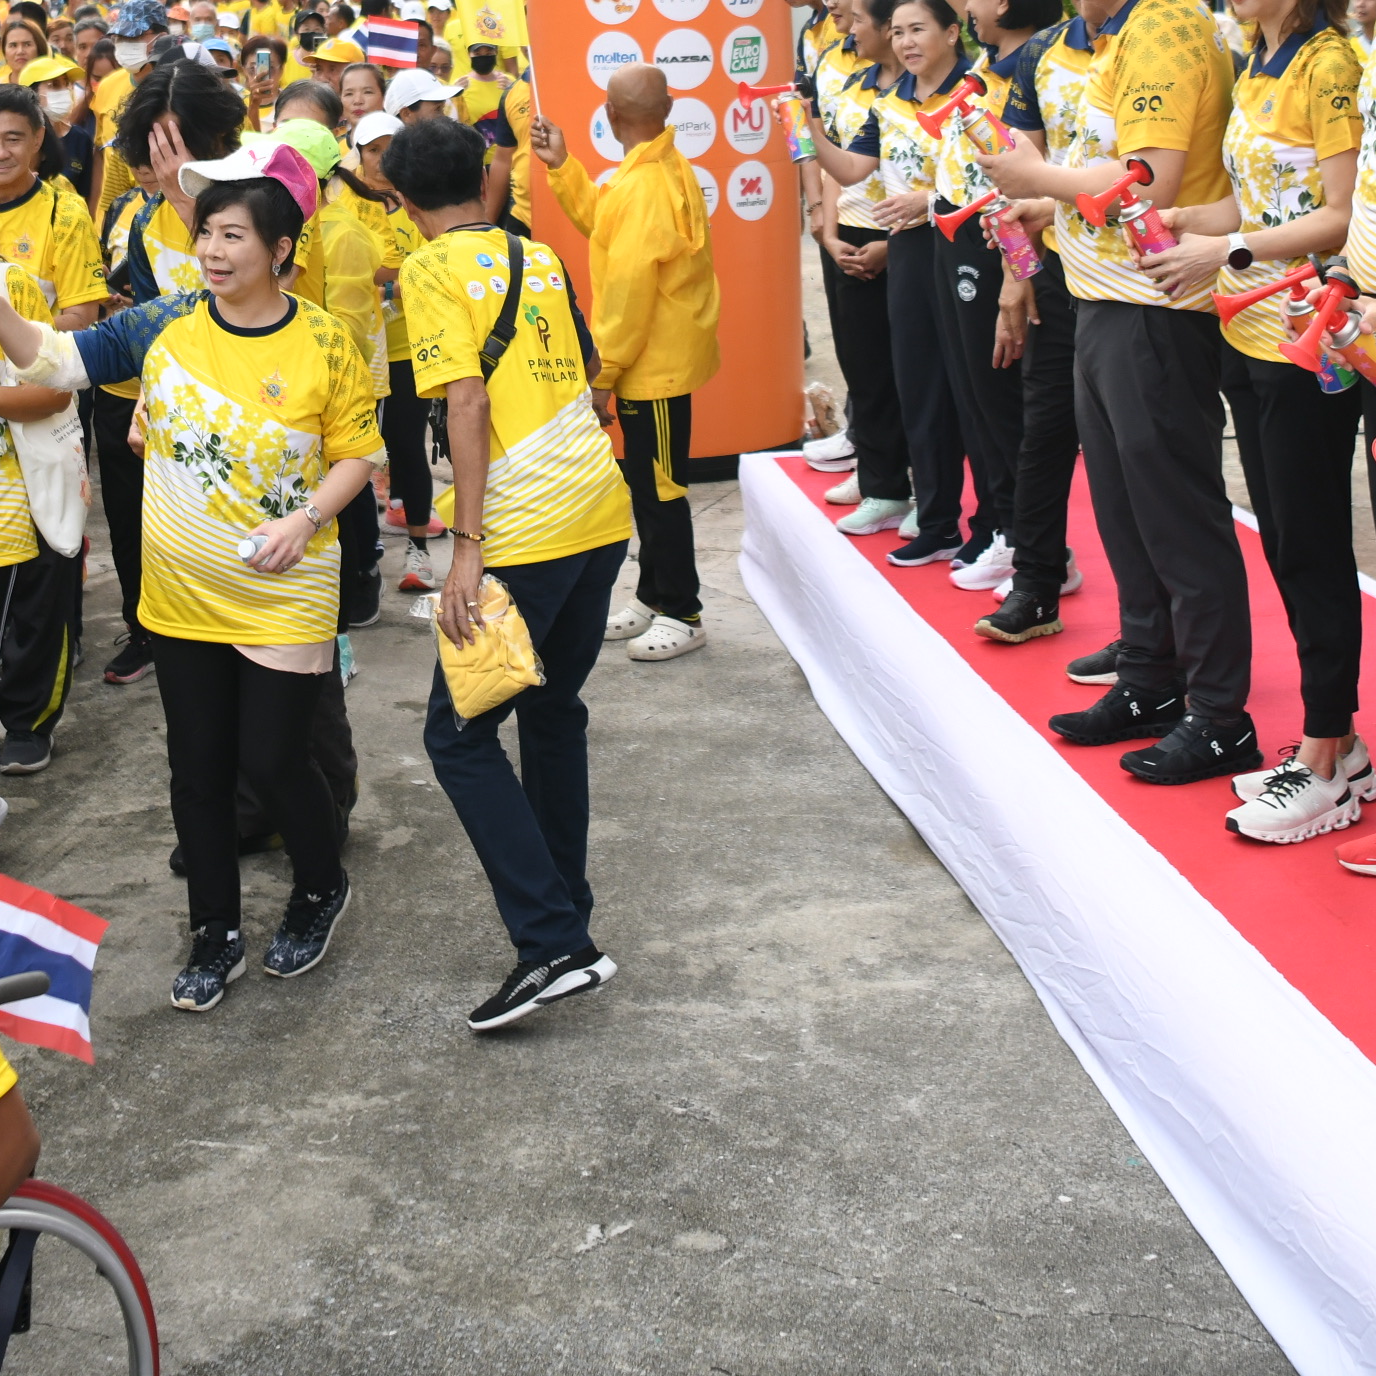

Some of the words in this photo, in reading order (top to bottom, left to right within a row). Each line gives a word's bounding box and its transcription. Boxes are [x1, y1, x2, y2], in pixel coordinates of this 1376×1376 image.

[732, 44, 760, 59] EURO
[593, 52, 637, 64] molten
[655, 54, 711, 65] MAZSA
[730, 57, 760, 71] CAKE
[732, 105, 764, 133] MU
[673, 121, 712, 133] edPark
[555, 357, 576, 369] RUN
